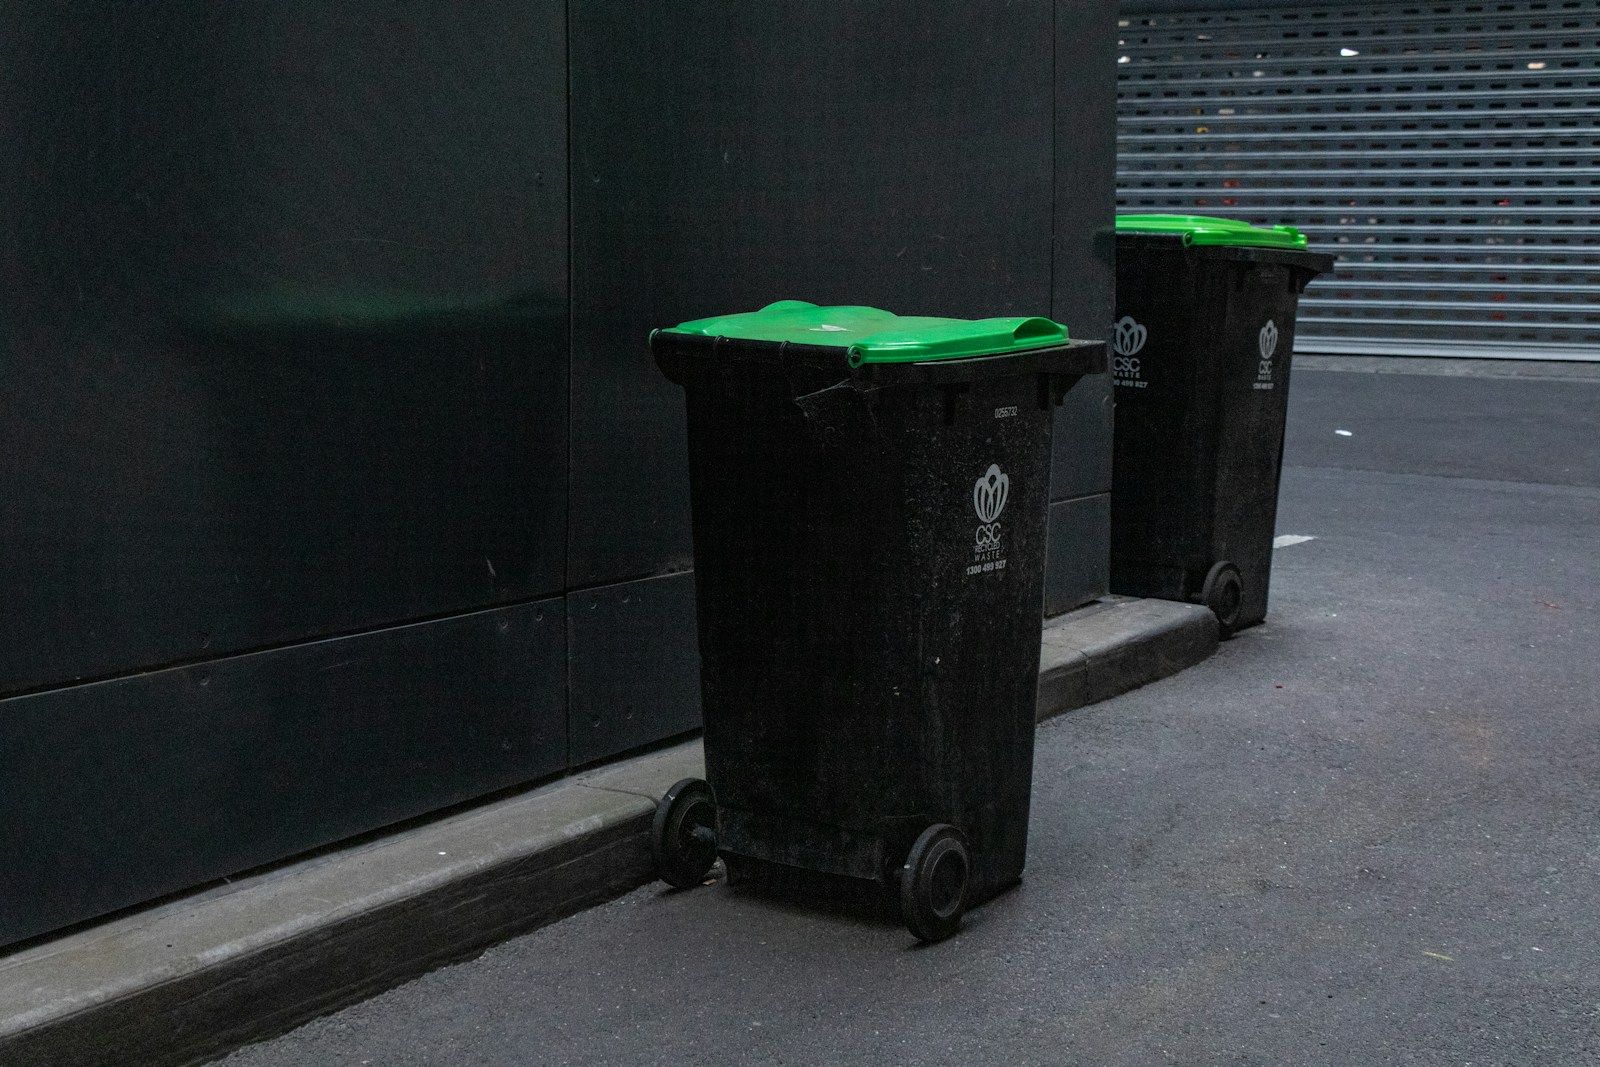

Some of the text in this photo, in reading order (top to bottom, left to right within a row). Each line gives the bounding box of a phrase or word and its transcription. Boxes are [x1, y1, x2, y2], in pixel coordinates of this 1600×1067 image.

[1113, 357, 1140, 372] CSC
[1258, 360, 1272, 374] CSC
[994, 405, 1018, 419] 0255732
[975, 522, 1001, 545] CSC
[974, 550, 1000, 562] WASTE
[966, 559, 1007, 575] 1300 499 927
